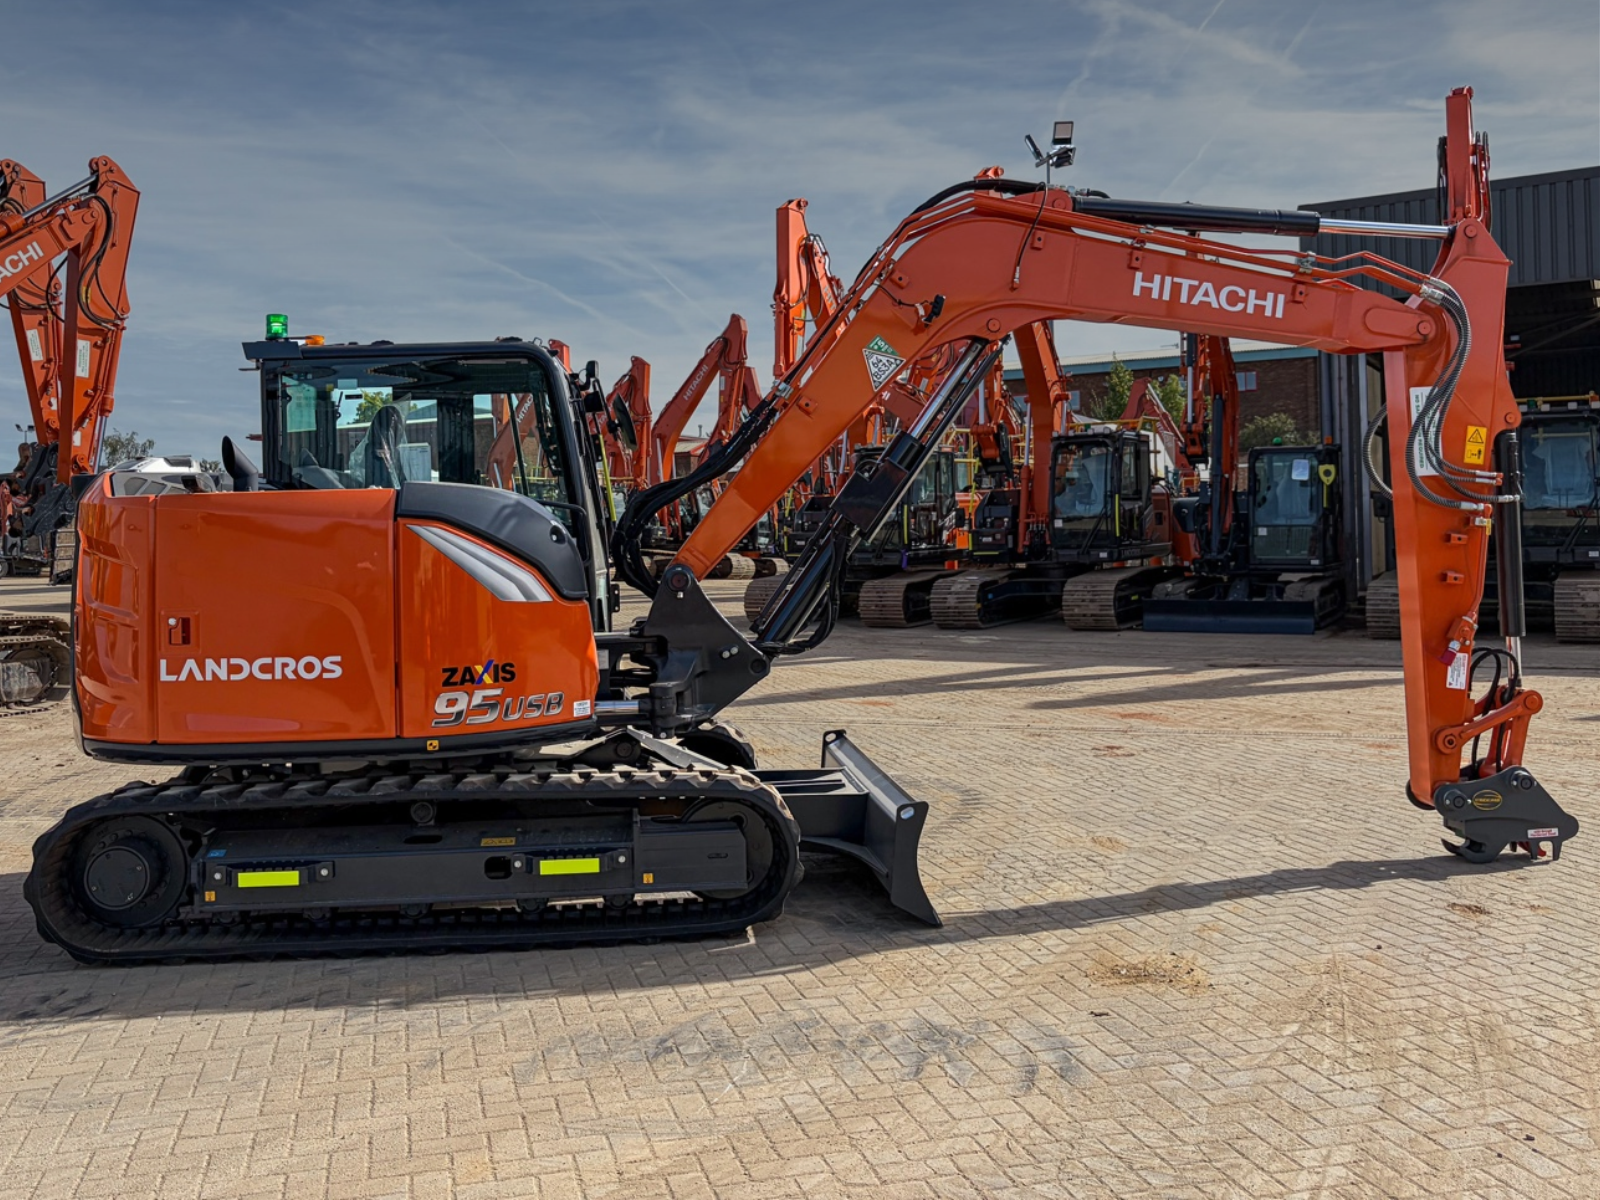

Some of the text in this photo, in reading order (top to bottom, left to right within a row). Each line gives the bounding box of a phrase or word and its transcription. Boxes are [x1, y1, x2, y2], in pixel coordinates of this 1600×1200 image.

[1132, 271, 1286, 319] HITACHI
[871, 356, 882, 368] 64
[872, 359, 895, 381] BS3A
[682, 364, 709, 401] HITACHI
[159, 655, 342, 683] LANDCROS
[442, 659, 516, 687] ZAXIS
